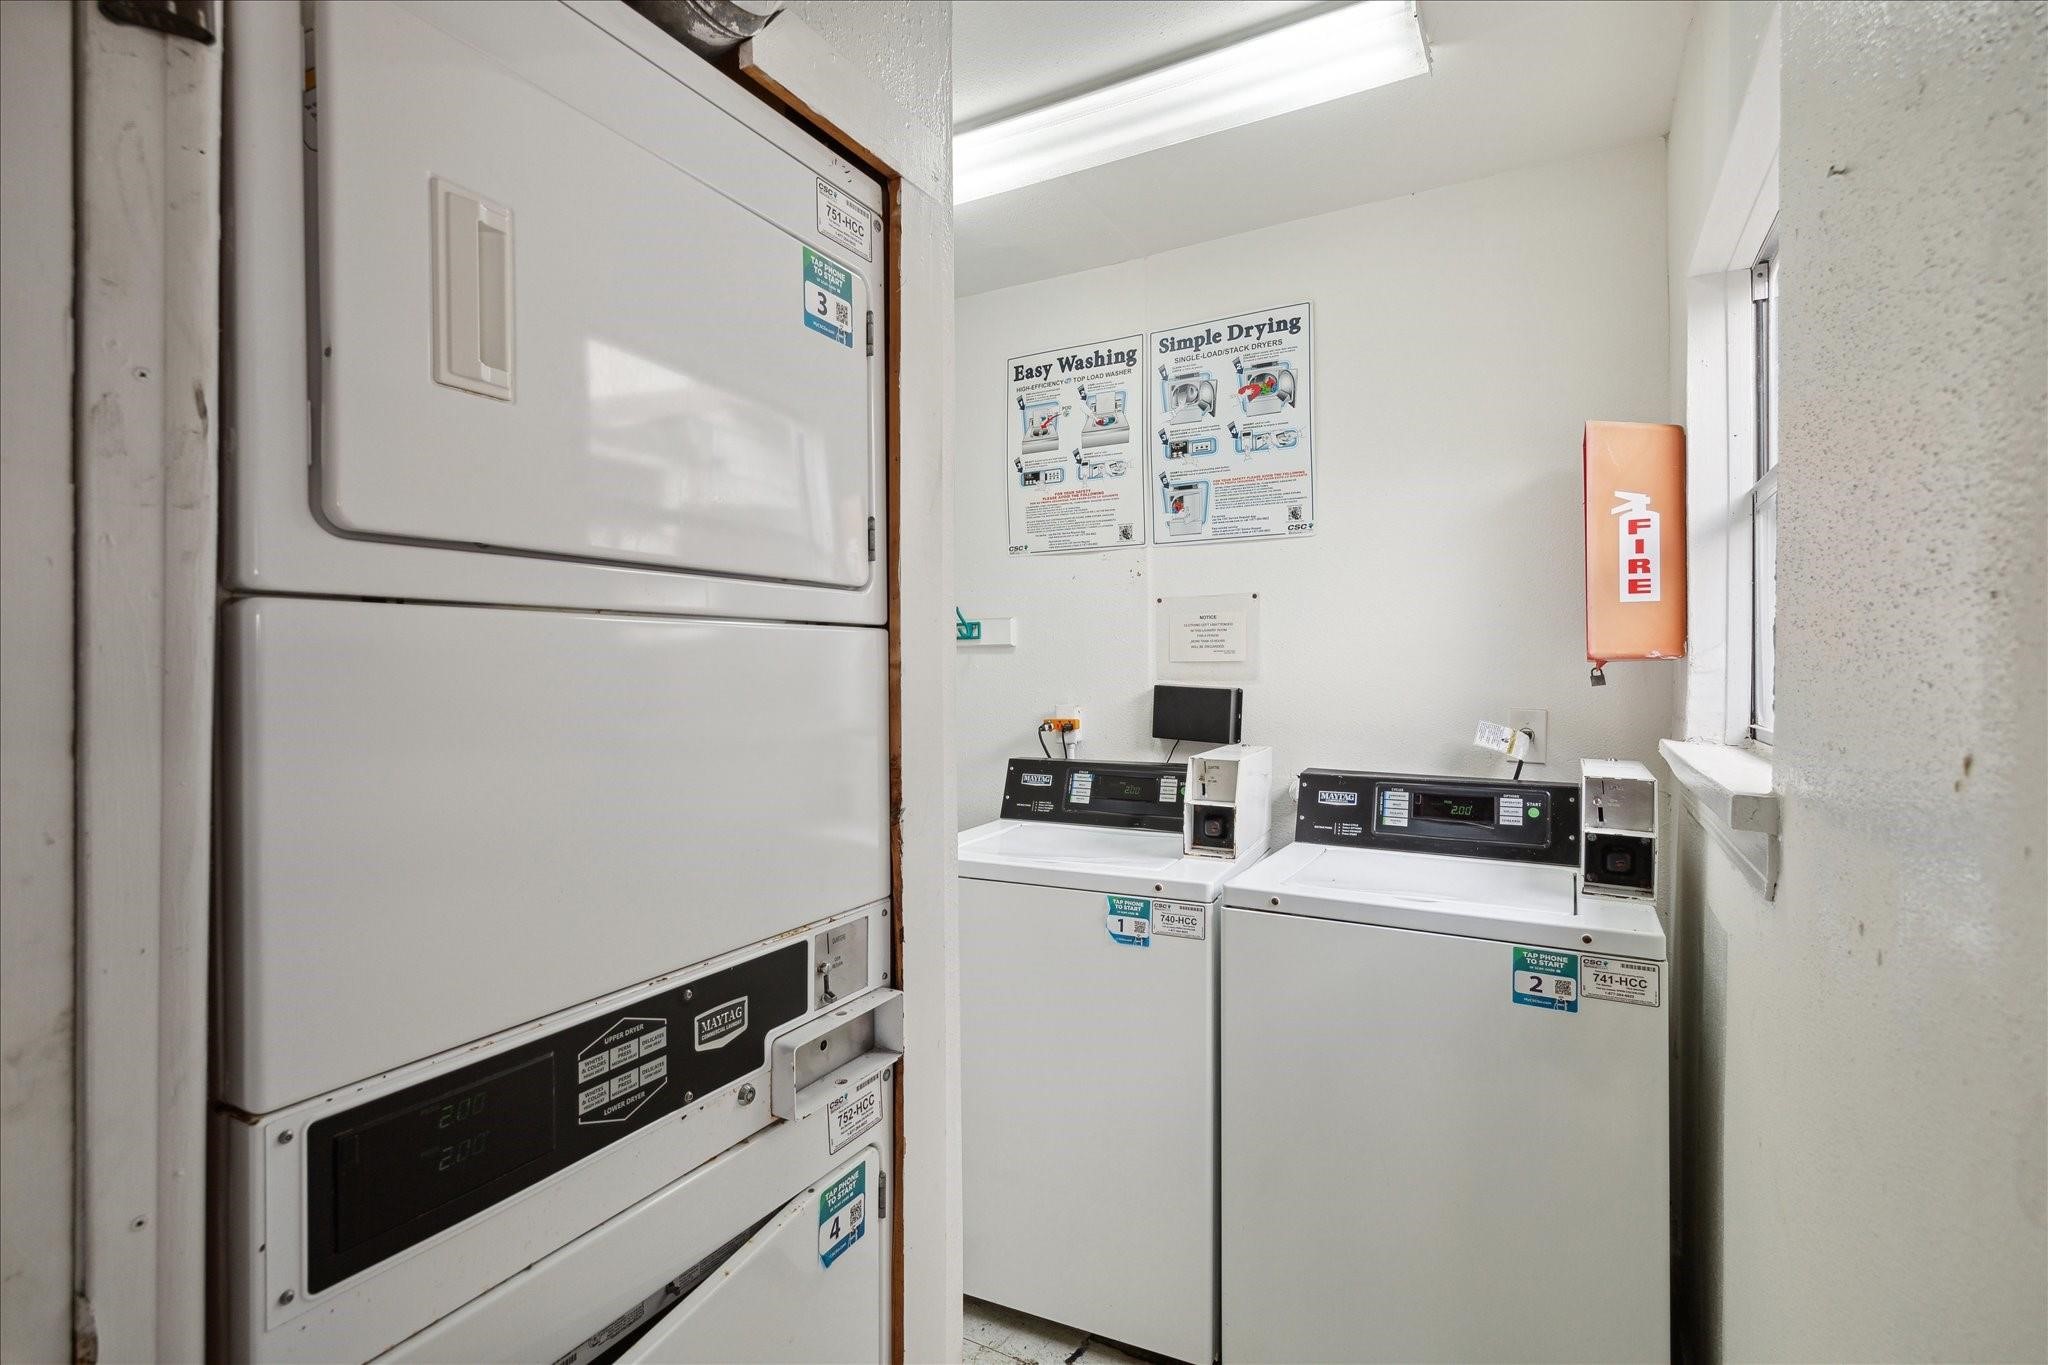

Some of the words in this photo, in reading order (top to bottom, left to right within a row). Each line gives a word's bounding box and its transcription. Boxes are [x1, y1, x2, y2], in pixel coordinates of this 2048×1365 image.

[819, 183, 833, 196] CSC
[826, 205, 864, 237] 751-HCC
[811, 256, 823, 268] TAP
[824, 263, 846, 281] PHONE
[813, 266, 823, 276] TO
[824, 271, 843, 288] START
[817, 291, 828, 316] 3
[1159, 328, 1222, 354] Simple
[1227, 316, 1301, 342] Drying
[1174, 345, 1250, 364] SINGLE-LOAD/STACK
[1251, 339, 1283, 350] DRYERS
[1013, 364, 1053, 382] Easy
[1057, 348, 1137, 373] Washing
[1016, 380, 1063, 393] HIGH-EFFICIENCY
[1087, 372, 1104, 380] LOAD
[1105, 369, 1132, 378] WASHER
[1287, 523, 1307, 531] CSC
[1628, 518, 1652, 594] FIRE
[1023, 775, 1050, 783] MAYTAG
[1321, 792, 1355, 800] MAYTAG
[1117, 919, 1124, 932] 1
[1161, 915, 1197, 926] 740-HCC
[1539, 960, 1564, 968] START
[1540, 953, 1568, 963] PHONE
[1529, 975, 1543, 993] 2
[1593, 972, 1648, 989] 741-HCC
[701, 1006, 742, 1034] MAYTAG
[604, 1031, 624, 1044] UPPER
[624, 1023, 645, 1036] DRYER
[641, 1032, 665, 1046] DELICATES
[584, 1055, 604, 1067] WHITES
[617, 1049, 632, 1058] PRESS
[587, 1060, 607, 1072] COLORS
[641, 1061, 665, 1075] DELICATES
[584, 1086, 604, 1098] WHITES
[617, 1079, 632, 1089] PRESS
[587, 1091, 607, 1103] COLORS
[603, 1102, 626, 1116] LOWER
[626, 1091, 646, 1105] DRYER
[830, 1096, 843, 1110] CSC
[838, 1094, 875, 1127] 752-HCC
[825, 1187, 837, 1200] TAP
[838, 1170, 859, 1190] PHONE
[827, 1196, 837, 1208] TO
[837, 1180, 857, 1199] START
[829, 1215, 841, 1239] 4
